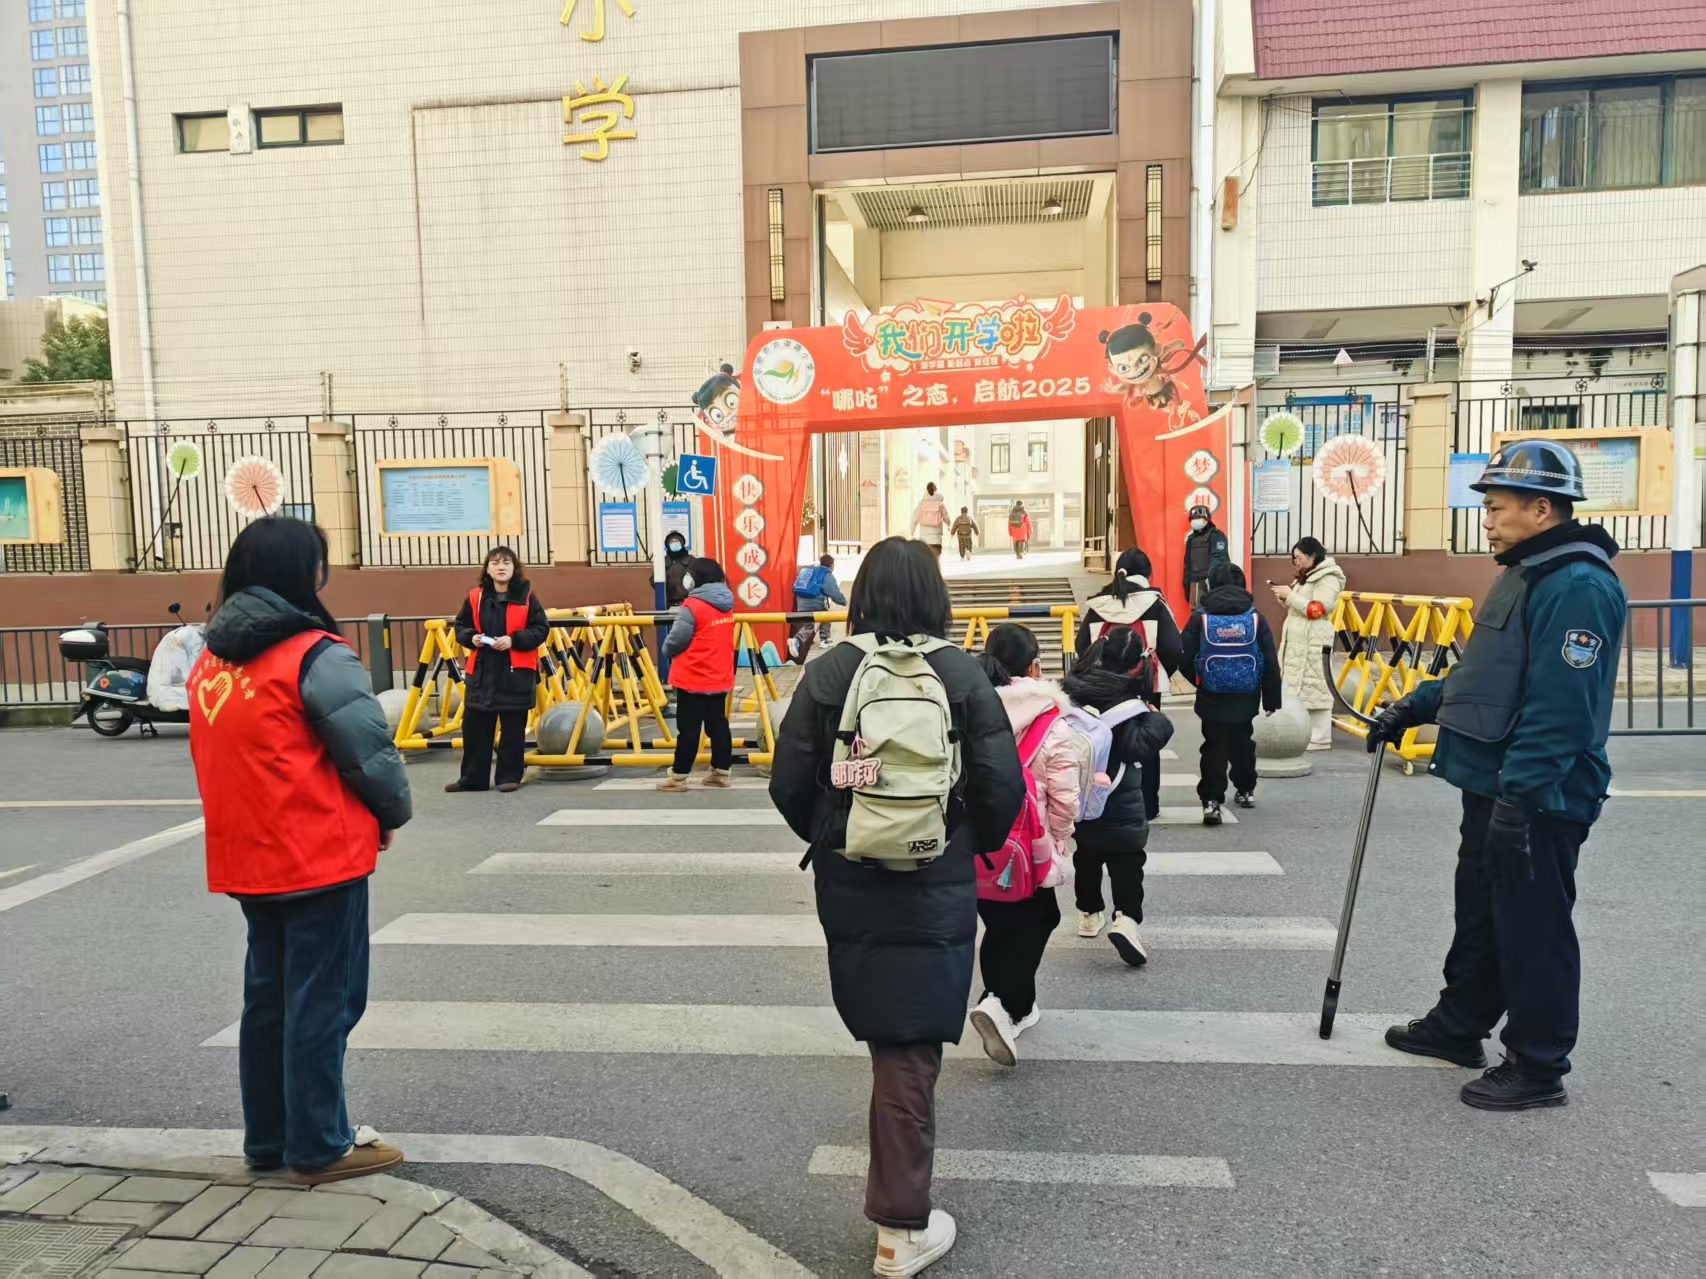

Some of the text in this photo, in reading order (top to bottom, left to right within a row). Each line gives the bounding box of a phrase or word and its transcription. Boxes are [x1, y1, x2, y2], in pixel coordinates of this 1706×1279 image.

[877, 309, 1042, 359] 我们开学啦
[739, 480, 762, 600] 快乐成长
